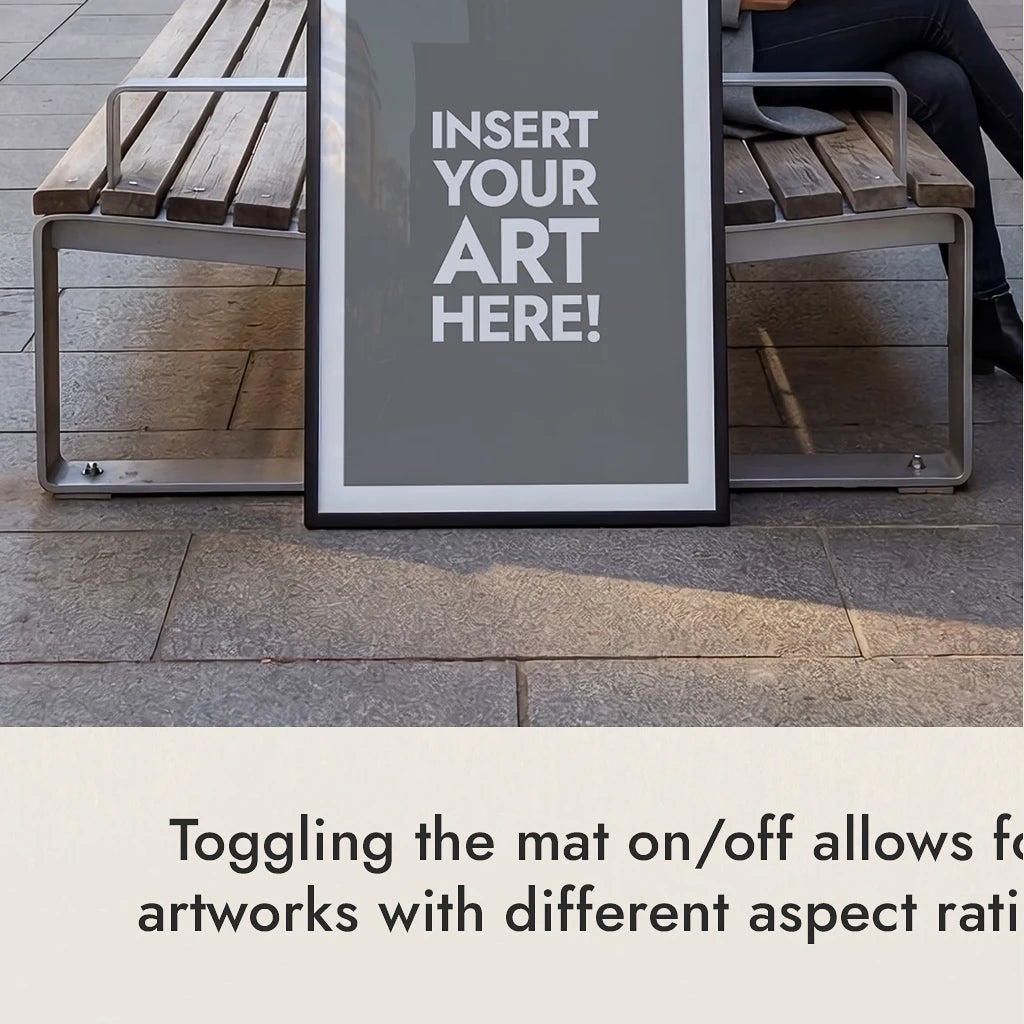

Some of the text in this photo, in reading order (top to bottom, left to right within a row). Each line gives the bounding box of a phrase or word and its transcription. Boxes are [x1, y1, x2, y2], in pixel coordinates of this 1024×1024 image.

[433, 110, 599, 149] INSERT
[433, 158, 599, 208] YOUR
[433, 215, 600, 284] ART
[432, 295, 601, 343] HERE!
